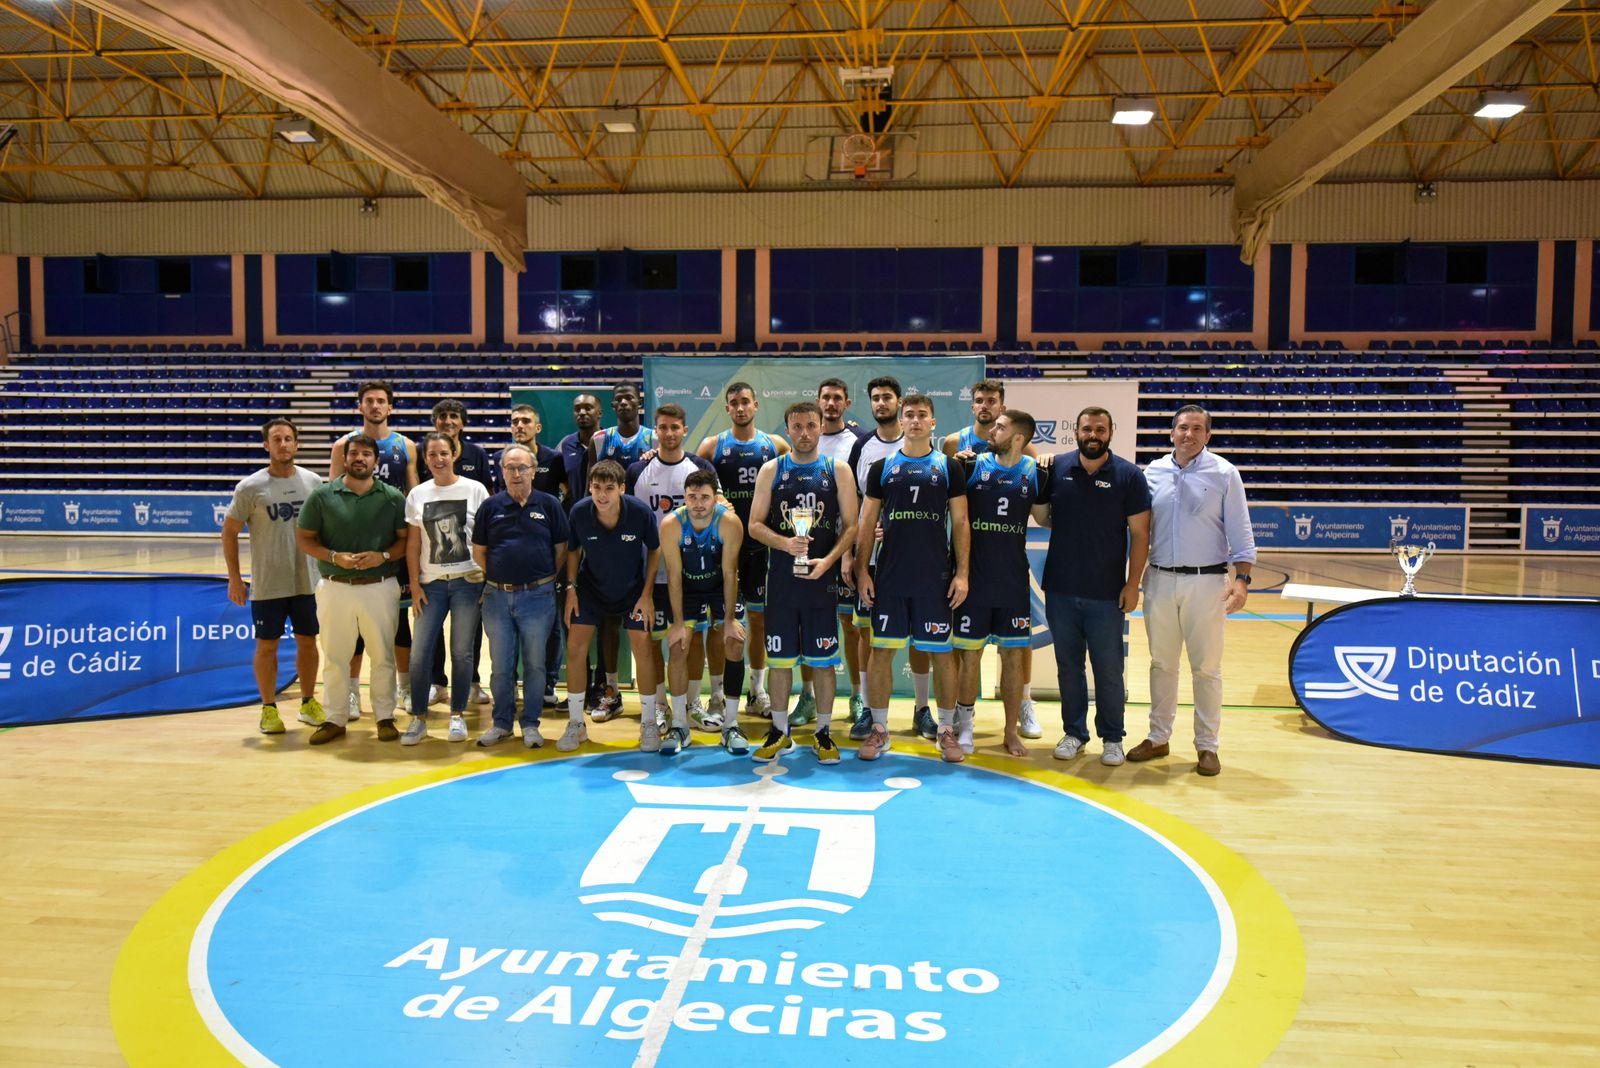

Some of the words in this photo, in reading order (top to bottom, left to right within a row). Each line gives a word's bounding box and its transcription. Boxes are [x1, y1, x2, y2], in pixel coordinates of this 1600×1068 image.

[1061, 435, 1073, 445] de
[738, 466, 757, 483] 29
[795, 492, 816, 508] 30
[910, 486, 919, 503] 7
[5, 507, 45, 516] Ayuntamiento
[82, 508, 122, 517] Ayuntamiento
[152, 509, 192, 518] Ayuntamiento
[997, 497, 1009, 516] 2
[14, 516, 42, 524] Algeciras
[90, 516, 119, 524] Algeciras
[160, 517, 189, 525] Algeciras
[1316, 521, 1365, 531] Ayuntamiento
[1411, 522, 1462, 532] Ayuntamiento
[1324, 531, 1360, 540] Algeciras
[1420, 532, 1457, 541] Algeciras
[879, 614, 889, 631] 7
[960, 615, 971, 633] 2
[24, 620, 167, 648] Diputación
[766, 635, 782, 653] 30
[22, 655, 56, 677] de
[68, 651, 141, 673] Cádiz
[1408, 646, 1561, 676] Diputación
[1410, 679, 1444, 702] de
[1456, 681, 1536, 709] Cádiz
[383, 936, 1000, 994] Ayuntamiento
[402, 985, 500, 1020] de
[505, 985, 947, 1042] Algeciras
